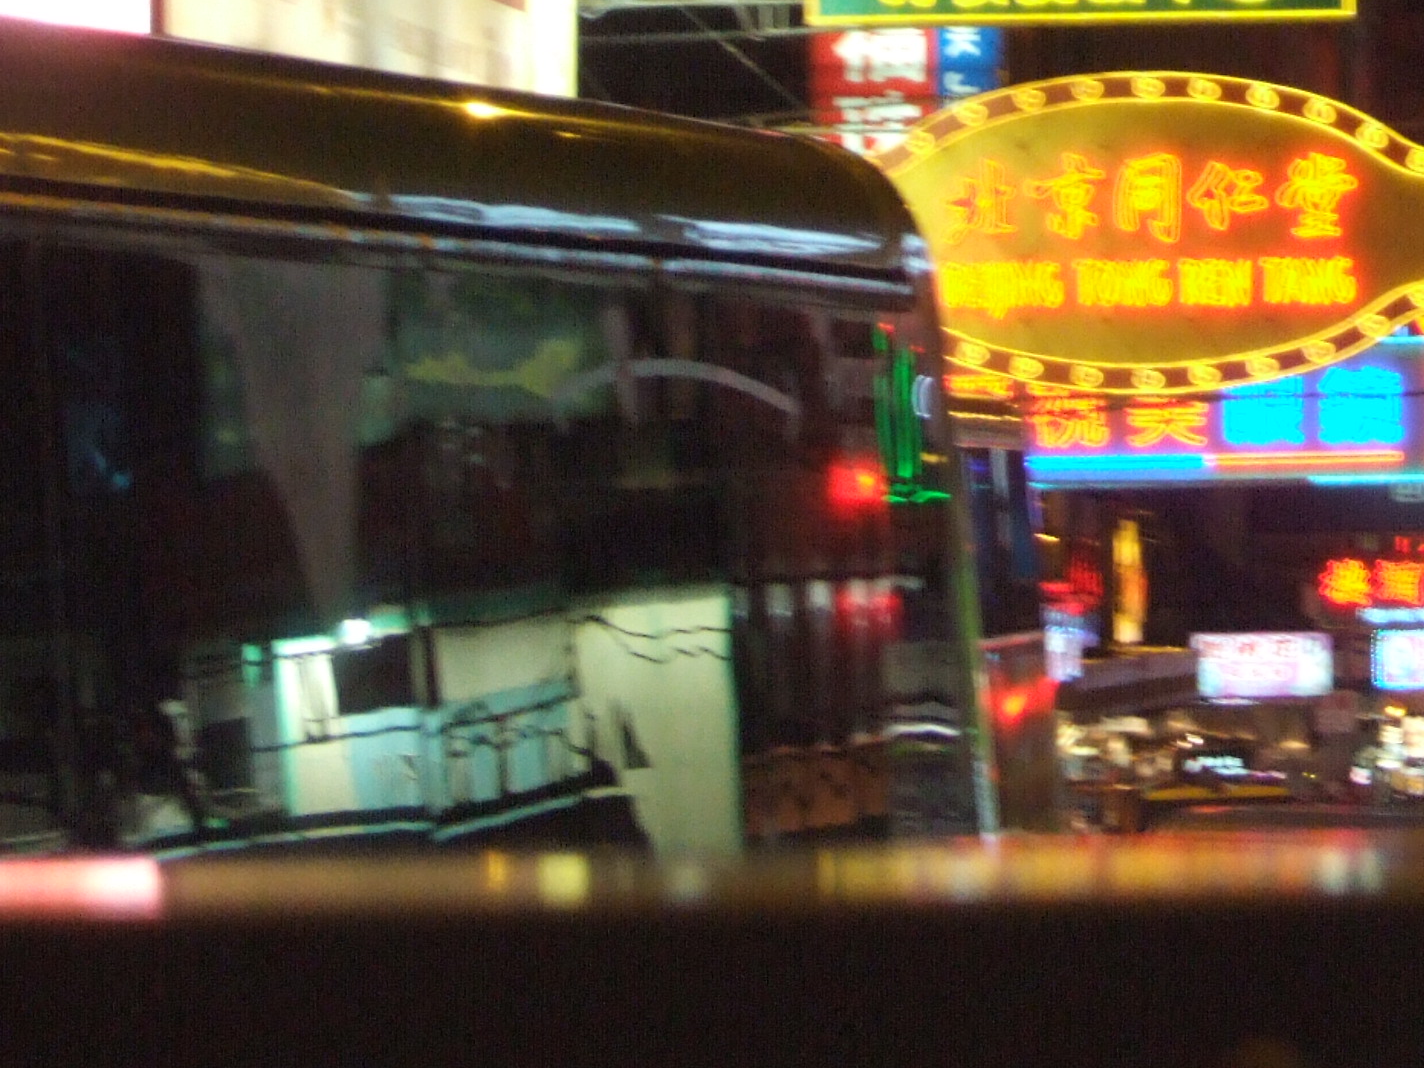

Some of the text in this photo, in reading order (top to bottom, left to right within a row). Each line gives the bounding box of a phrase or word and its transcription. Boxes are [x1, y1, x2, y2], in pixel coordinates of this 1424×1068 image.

[943, 151, 1359, 245] 北京同仁堂
[1177, 257, 1254, 307] REN
